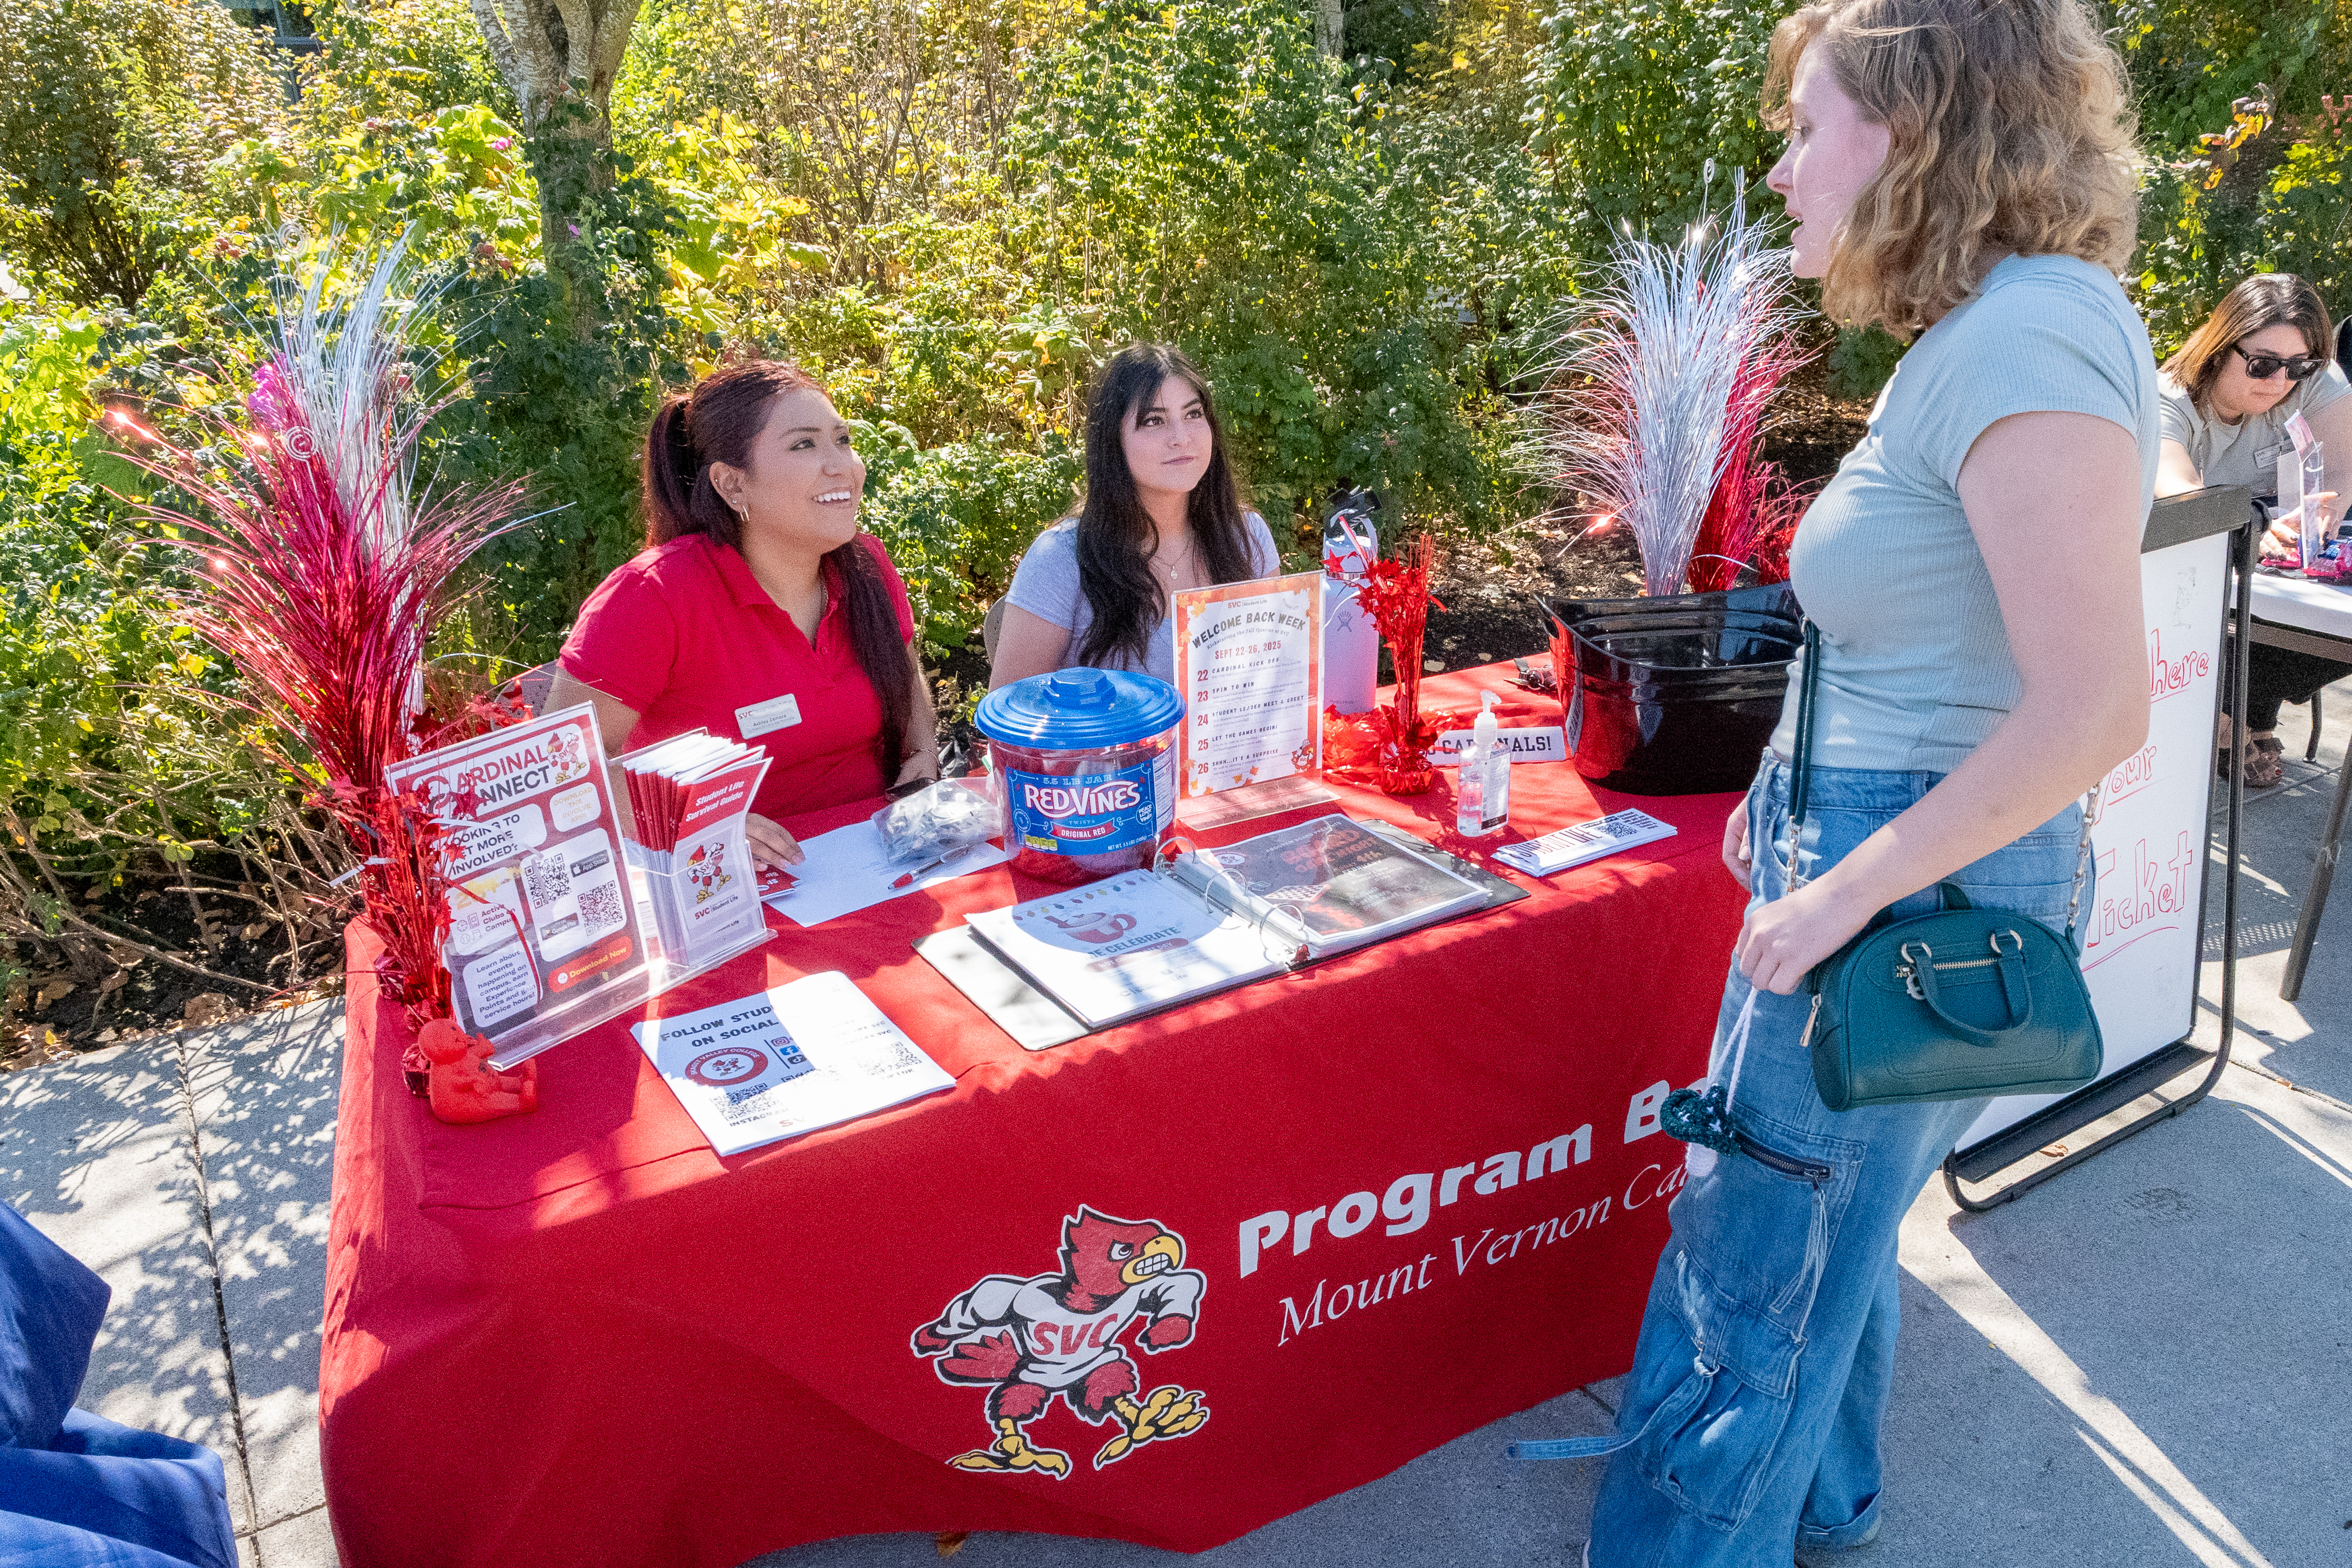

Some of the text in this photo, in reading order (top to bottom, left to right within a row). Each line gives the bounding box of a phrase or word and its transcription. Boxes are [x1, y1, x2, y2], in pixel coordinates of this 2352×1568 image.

[1192, 612, 1306, 649] WELCOME BACK WEEK
[1207, 633, 1236, 650] Kickstarting
[1215, 641, 1281, 659] SEPT 22-26, 2025
[1212, 664, 1245, 674] CARDINAL
[2151, 628, 2209, 696] here
[1197, 669, 1209, 682] 22
[1197, 690, 1209, 703] 23
[738, 710, 753, 720] SVC
[769, 714, 786, 722] Zamora
[1212, 708, 1237, 717] STUDENT
[1240, 704, 1261, 712] LEADER
[1197, 714, 1209, 726] 24
[1259, 724, 1278, 733] BEGIN!
[1198, 738, 1209, 751] 25
[1443, 736, 1552, 754] CANALS!
[1252, 749, 1279, 758] SURPRISE
[1198, 762, 1209, 774] 26
[1043, 775, 1112, 785] 5.5 LB JAR
[553, 787, 593, 806] DOWNLOAD
[695, 781, 745, 806] Student Life
[563, 803, 592, 818] INVOLVE
[568, 798, 582, 808] THE
[686, 791, 744, 822] Survival Guide
[1138, 804, 1152, 813] PEACE
[503, 814, 520, 826] TO
[1139, 809, 1152, 817] LOVE
[1140, 813, 1152, 822] VINES
[477, 830, 514, 851] MORE
[1061, 827, 1106, 838] ORIGINAL RED
[1266, 839, 1293, 853] PROGRAM
[1293, 830, 1314, 842] BOARD
[1504, 834, 1576, 855] STUDENT
[1558, 827, 1603, 843] LIFE
[593, 857, 607, 866] Store
[700, 858, 713, 872] SVC
[1342, 860, 1382, 874] FEBRUARY
[2088, 830, 2193, 948] Ticket
[695, 907, 710, 920] SVC
[712, 899, 730, 912] Student
[483, 912, 505, 924] Clubs
[486, 917, 516, 932] Campu
[551, 923, 567, 935] Google
[1105, 926, 1181, 953] CELEBRATE
[476, 951, 521, 973] Learn about
[569, 946, 627, 978] Download Now
[1098, 960, 1115, 968] HOT
[1158, 941, 1172, 950] DAY
[488, 962, 513, 976] events
[478, 968, 516, 989] happening
[480, 972, 528, 996] campus, earn
[486, 981, 526, 1002] Experience
[479, 999, 504, 1013] Points
[506, 991, 519, 1002] and
[485, 991, 535, 1019] service hours!
[660, 1004, 774, 1042] FOLLOW STUD
[691, 1019, 779, 1047] ON SOCIAL
[700, 1048, 729, 1061] VALLEY
[730, 1048, 760, 1059] COLLEGE
[1240, 1123, 1592, 1279] Program
[1278, 1253, 1437, 1347] Mount
[1452, 1195, 1611, 1277] Vernon
[1031, 1313, 1118, 1356] SVC
